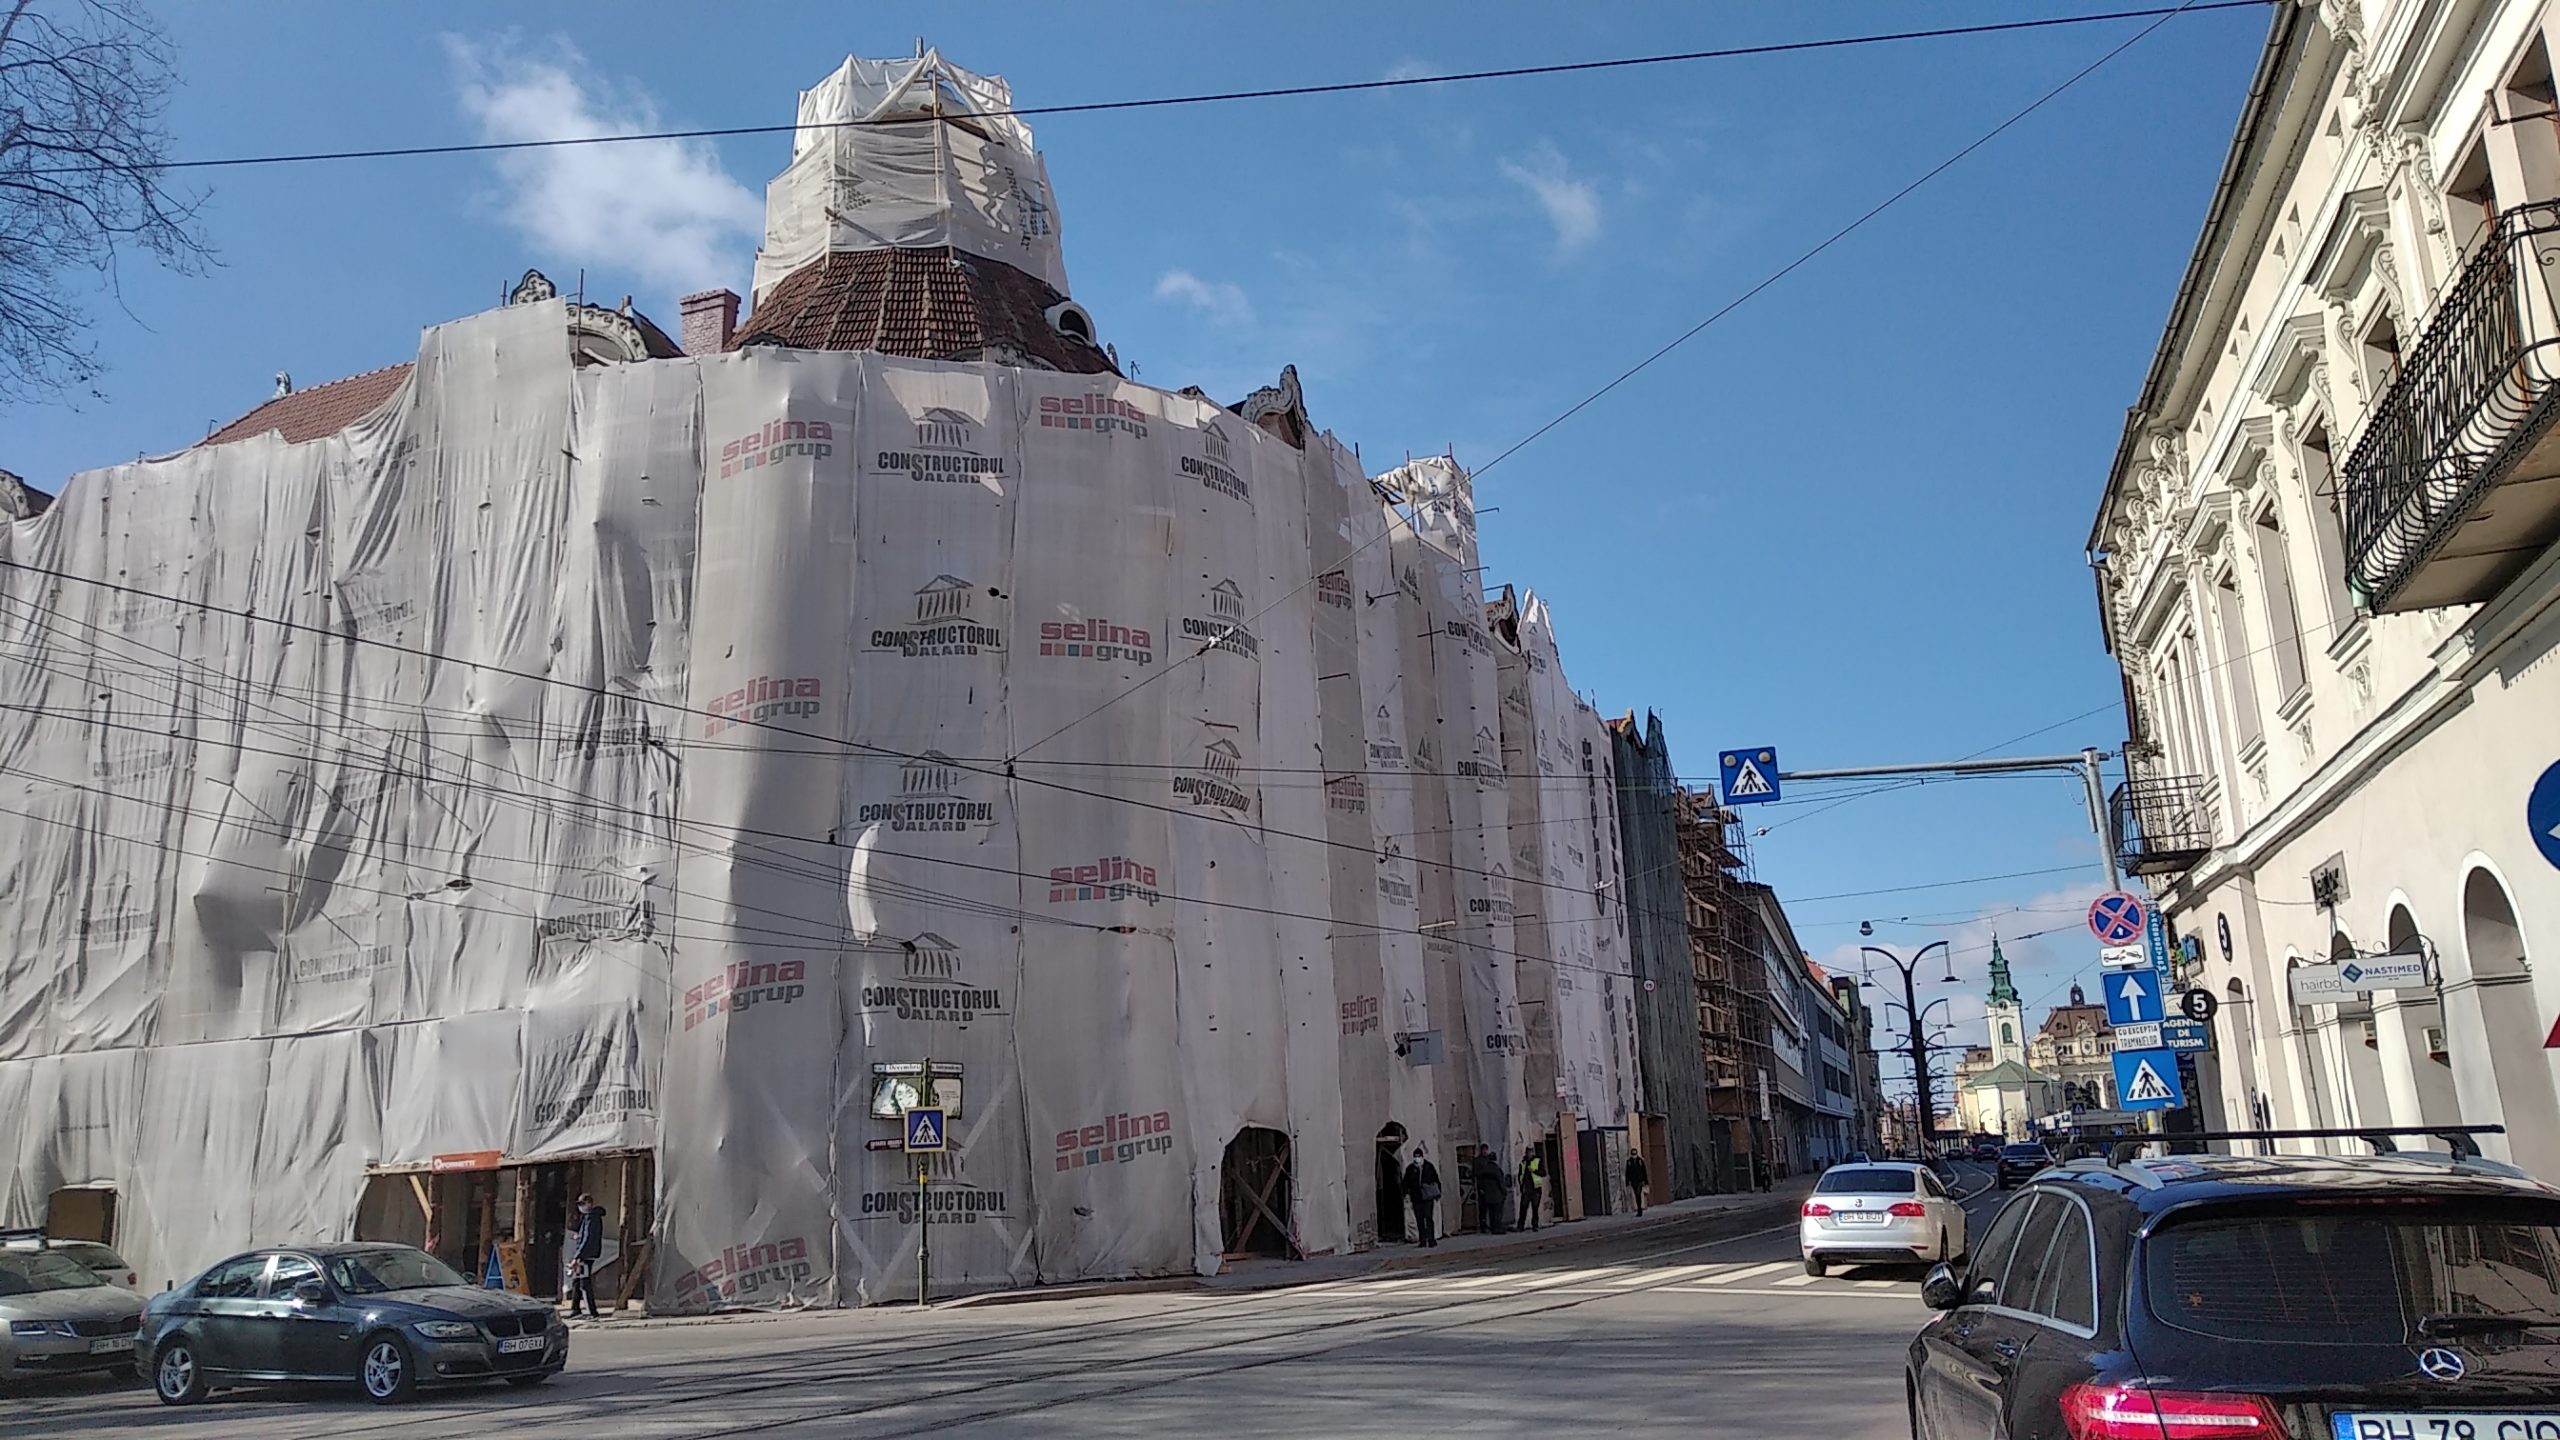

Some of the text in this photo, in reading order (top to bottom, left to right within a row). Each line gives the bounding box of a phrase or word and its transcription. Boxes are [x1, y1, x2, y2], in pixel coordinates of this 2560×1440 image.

[1040, 393, 1146, 424] selina
[721, 418, 833, 463] selina
[1095, 416, 1148, 440] grup
[769, 442, 832, 467] grup
[878, 451, 1004, 475] CONSTRUCTORUL
[1180, 455, 1250, 500] CONSTRUCTORUL
[870, 624, 1001, 648] CONSTRUCTORUL
[1040, 618, 1151, 649] selina
[1096, 644, 1153, 667] grup
[704, 676, 821, 719] selina
[753, 700, 820, 723] grup
[859, 801, 993, 824] CONSTRUCTORUL
[1050, 855, 1157, 887] selina
[1109, 882, 1160, 907] grup
[2364, 963, 2421, 976] NASTIMED
[684, 959, 806, 1010] selina
[732, 982, 805, 1013] grup
[861, 986, 1001, 1009] CONSTRUCTORUL
[2192, 993, 2207, 1012] 5
[2166, 1037, 2205, 1049] TURISM
[2177, 1028, 2191, 1038] DE
[1055, 1109, 1172, 1153] selina
[1117, 1133, 1173, 1164] grup
[861, 1190, 1007, 1214] CONSTRUCTORUL
[674, 1236, 808, 1299] selina
[738, 1261, 811, 1294] grup
